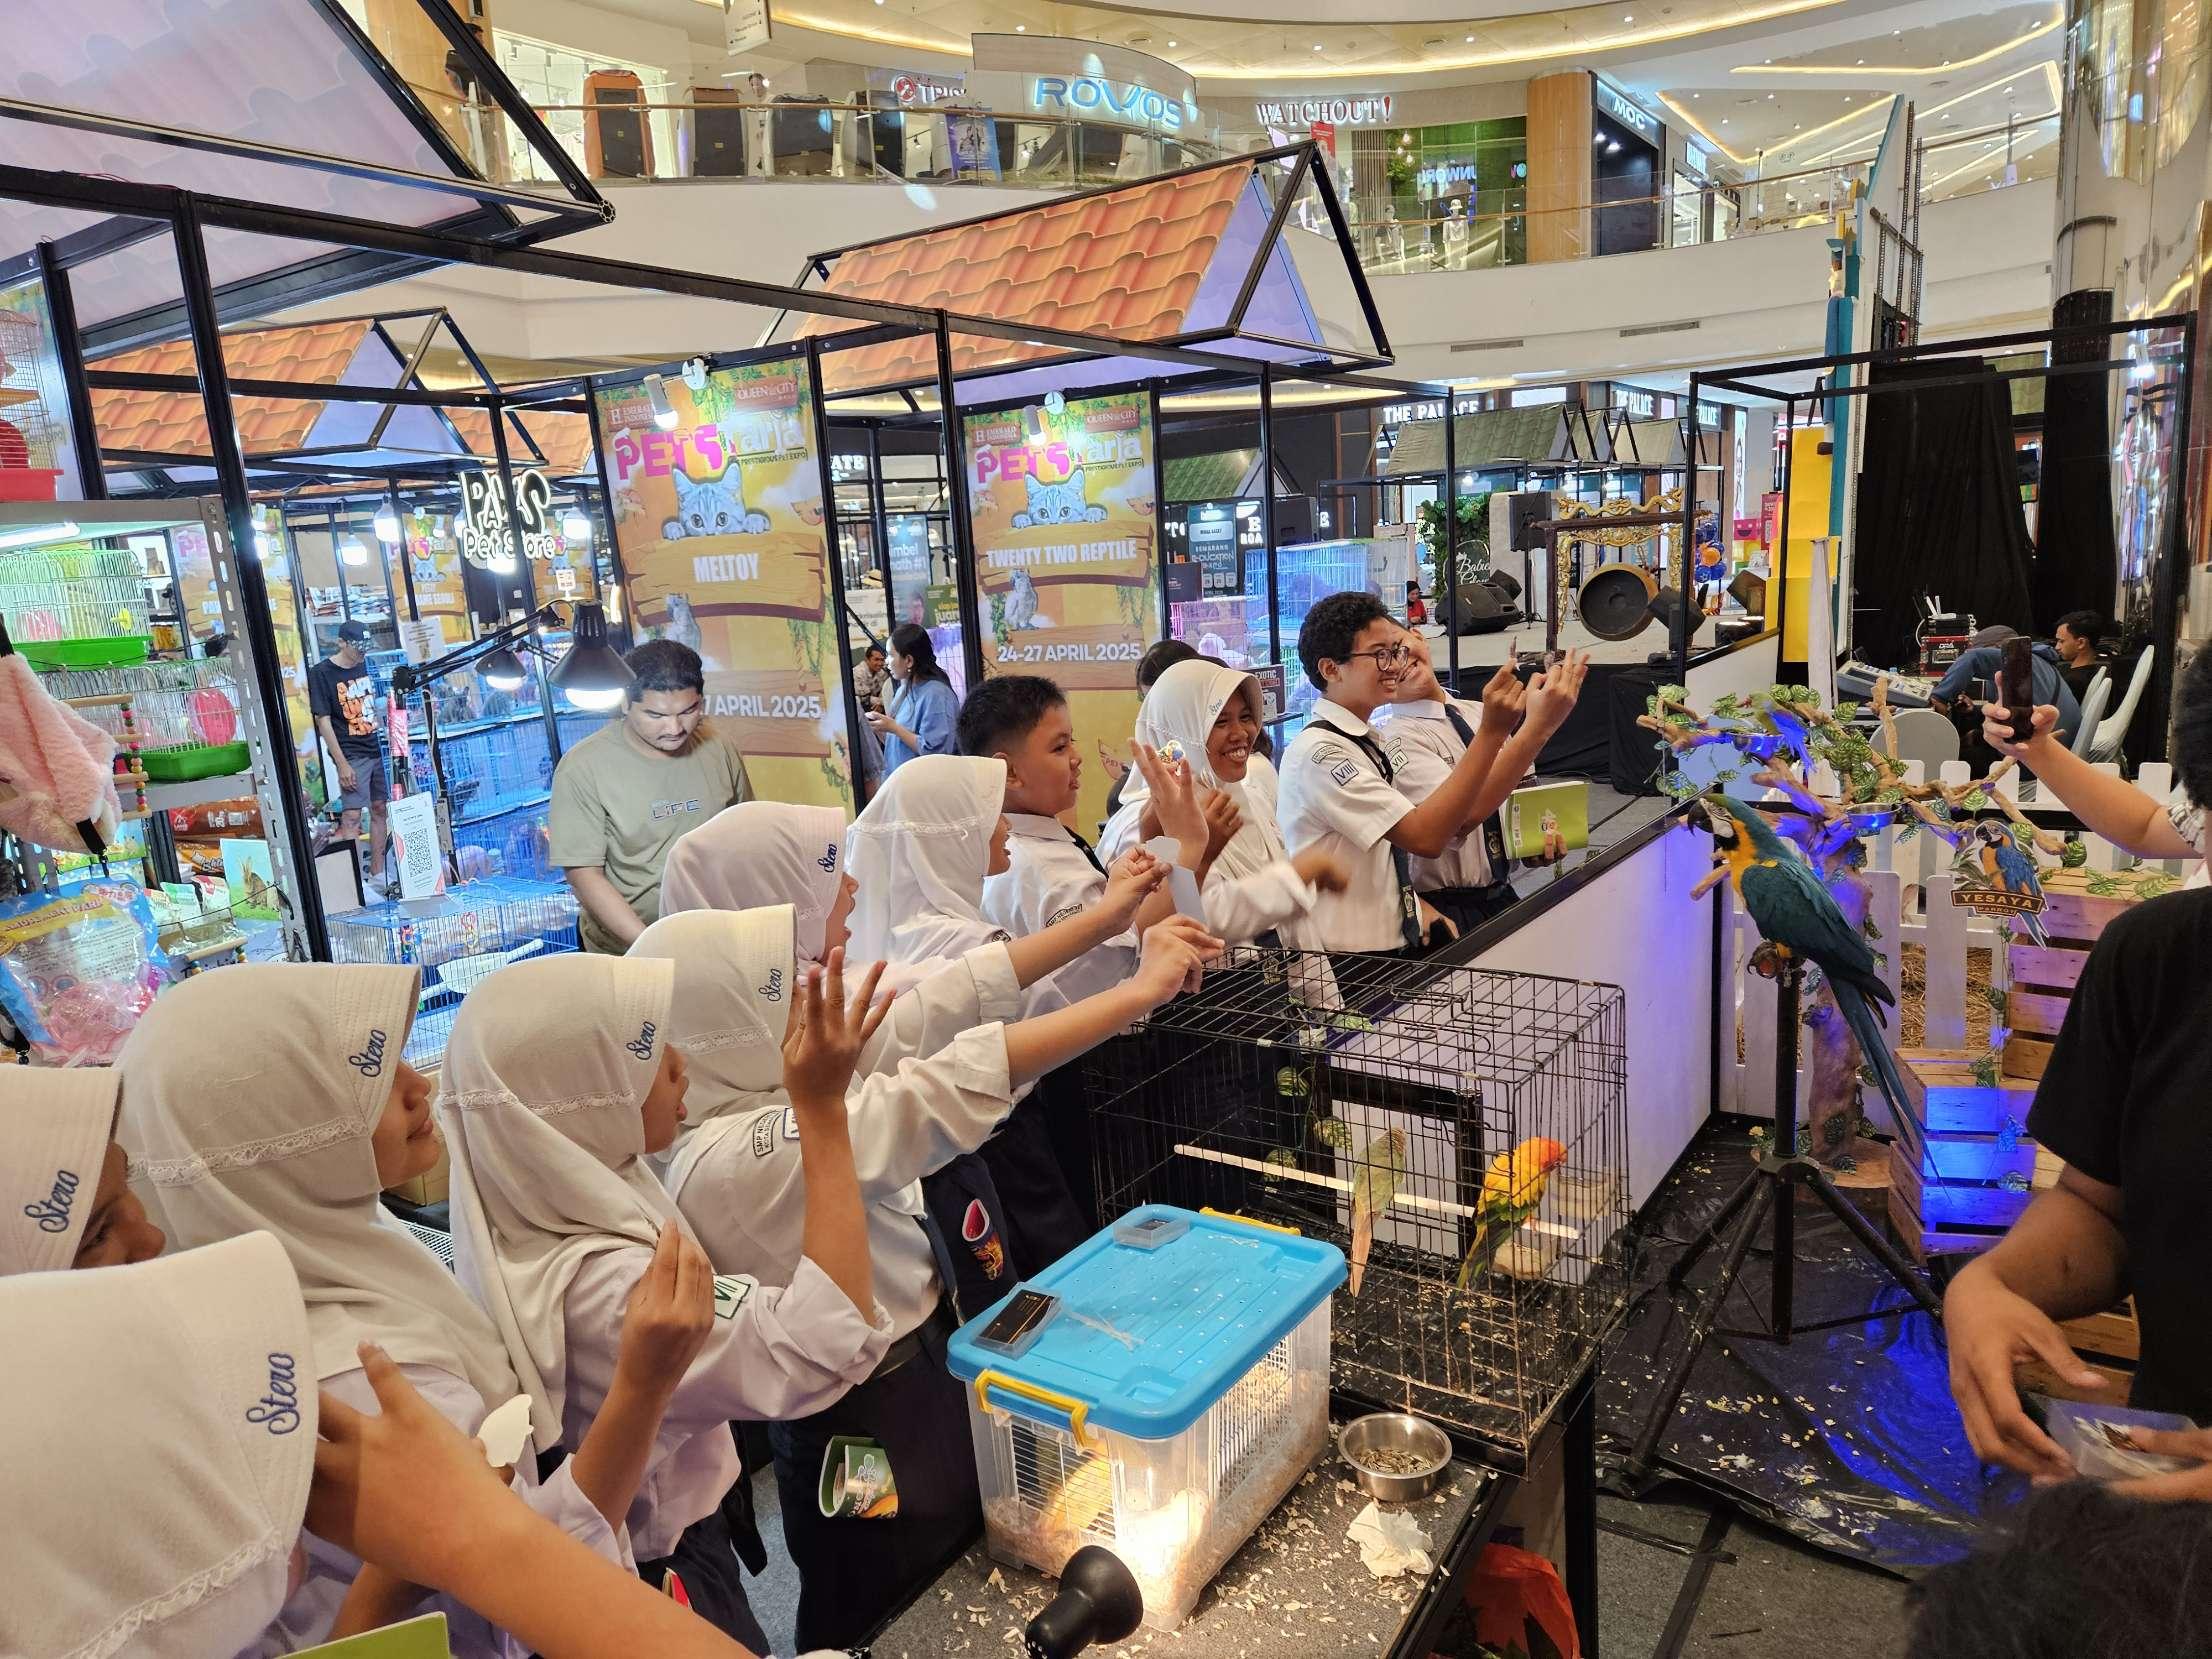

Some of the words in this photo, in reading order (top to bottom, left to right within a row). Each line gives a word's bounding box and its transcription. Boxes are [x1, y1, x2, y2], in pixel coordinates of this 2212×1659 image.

[1383, 405, 1411, 425] THE
[462, 527, 502, 561] Pet
[502, 529, 557, 561] Sore
[986, 546, 1042, 569] TWENTY
[1045, 544, 1077, 565] TWO
[1080, 538, 1137, 562] REPTILE
[693, 553, 760, 583] MELTOY
[997, 644, 1043, 662] 24-27
[1045, 643, 1096, 661] APRIL
[1096, 642, 1142, 661] 2025
[715, 695, 770, 717] APRIL
[769, 695, 823, 719] 2025
[1335, 762, 1355, 780] VIII
[817, 843, 838, 874] Stero
[1962, 894, 2033, 908] YESAYA
[758, 967, 783, 1003] Stero
[348, 1029, 388, 1079] Stero
[625, 1020, 657, 1061] Stero
[24, 1169, 81, 1234] Stero
[246, 1352, 301, 1436] Stero
